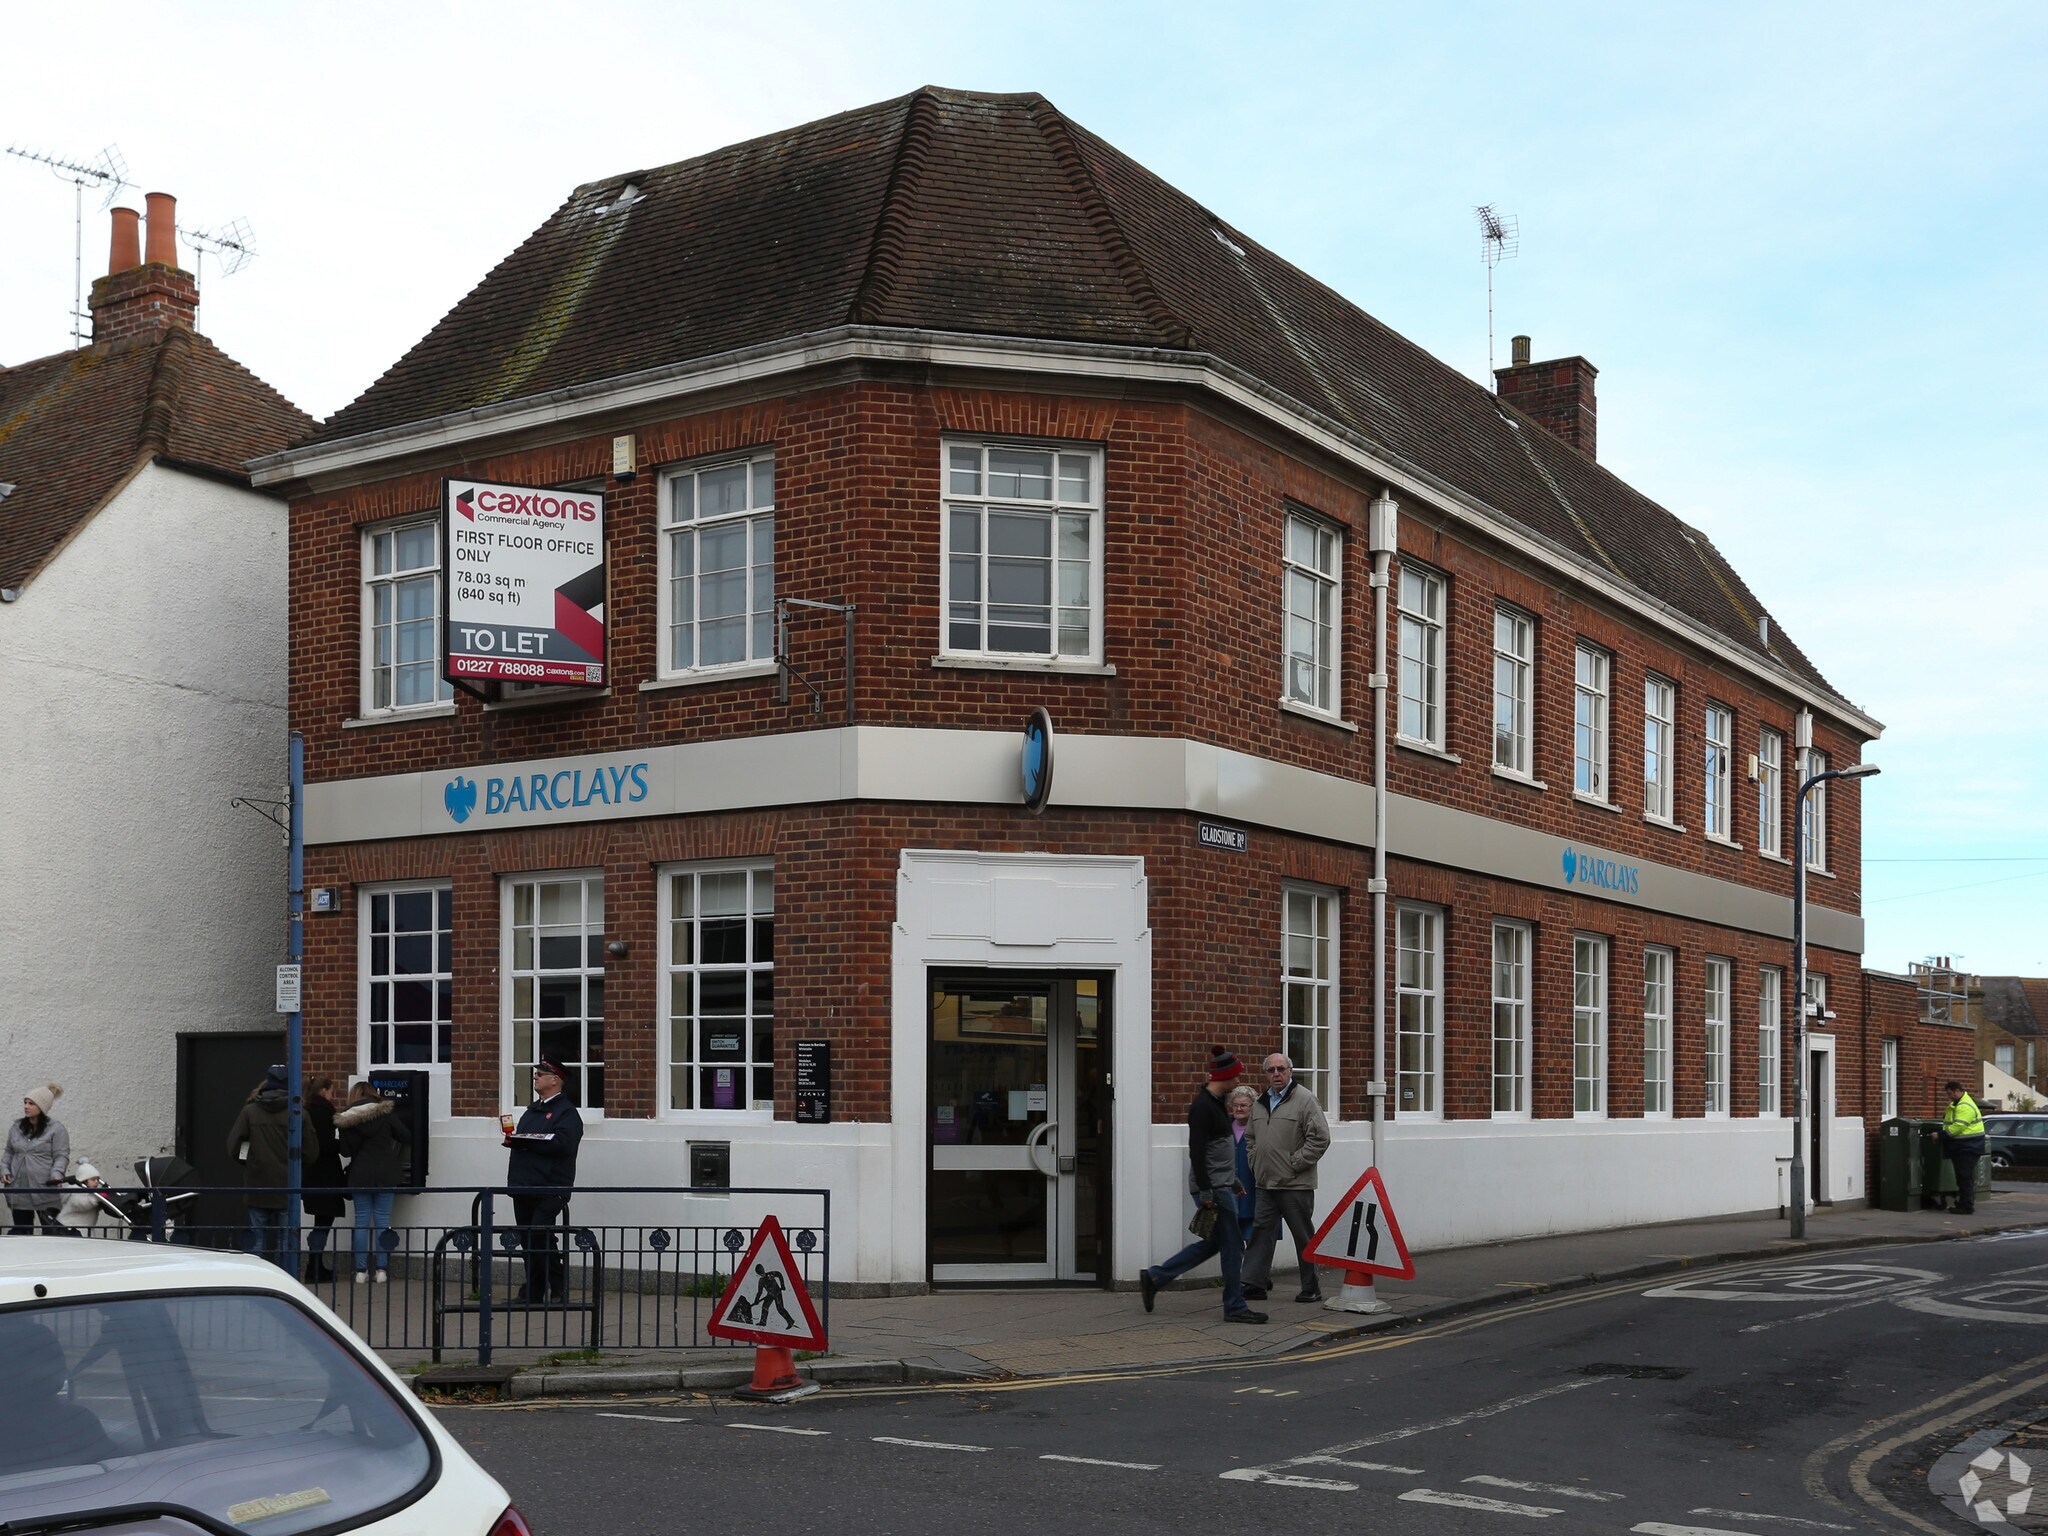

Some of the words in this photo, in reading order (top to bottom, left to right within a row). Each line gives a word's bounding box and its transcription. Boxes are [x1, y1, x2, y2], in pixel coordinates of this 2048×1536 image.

[478, 491, 596, 522] caxtons
[478, 513, 530, 526] Commercial
[533, 518, 565, 531] Agency
[457, 530, 494, 545] FIRST
[499, 534, 543, 551] FLOOR
[547, 539, 594, 555] OFFICE
[457, 548, 491, 563] ONLY
[457, 571, 491, 585] 78.03
[495, 576, 510, 589] sq
[514, 577, 525, 587] m
[457, 587, 485, 601] (840
[489, 591, 504, 605] sq
[507, 591, 521, 606] ft)
[460, 628, 495, 651] TO
[501, 631, 549, 655] LET
[457, 659, 494, 673] 01227
[497, 662, 545, 677] 788088
[546, 668, 585, 676] caxtons.com
[485, 763, 648, 815] BARCLAYS
[1201, 826, 1236, 847] GLADSTONE
[1579, 853, 1639, 895] BARCLAYS
[380, 1080, 408, 1088] BARCLAYS
[1713, 1271, 1896, 1290] 20
[235, 1505, 261, 1518] SAIL
